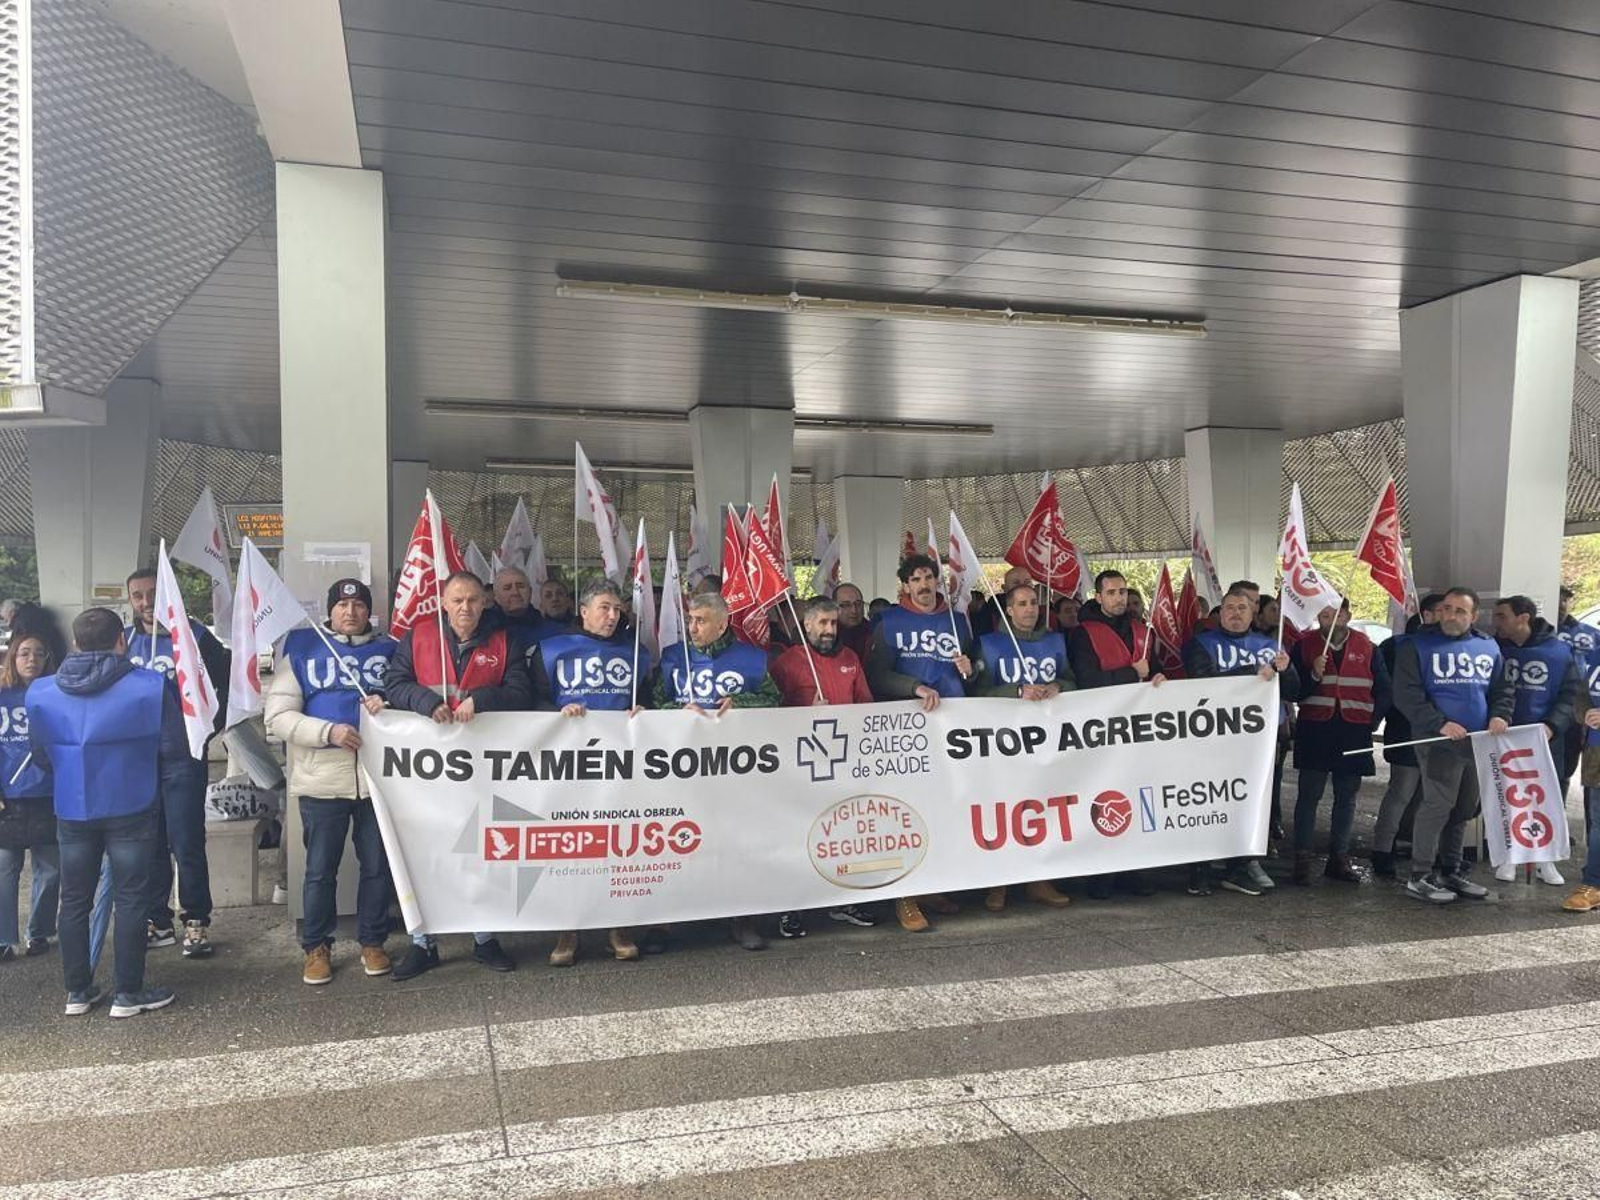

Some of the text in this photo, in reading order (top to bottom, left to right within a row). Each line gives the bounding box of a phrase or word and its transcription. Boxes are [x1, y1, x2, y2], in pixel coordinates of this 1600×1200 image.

[556, 656, 633, 688] USO
[999, 656, 1057, 683] USO
[1432, 652, 1494, 679] USO
[672, 668, 745, 697] USO
[863, 712, 926, 733] SERVIZO
[946, 698, 1266, 760] STOP AGRESIÓNS
[859, 734, 929, 755] GALEGO
[383, 738, 780, 782] NOS TAMÉN SOMOS
[852, 753, 930, 778] de SAÚDE
[1162, 778, 1248, 808] FeSMC
[1499, 748, 1554, 849] USO
[551, 807, 685, 821] UNIÓN SINDICAL OBRERA
[821, 799, 912, 837] VIGILANTE
[857, 819, 876, 834] DE
[970, 795, 1079, 851] UGT
[1164, 810, 1228, 830] A Coruña
[817, 833, 922, 859] SEGURIDAD
[610, 862, 682, 874] TRABAJADORES
[610, 875, 664, 886] SEGURIDAD
[610, 887, 652, 898] PRIVADA
